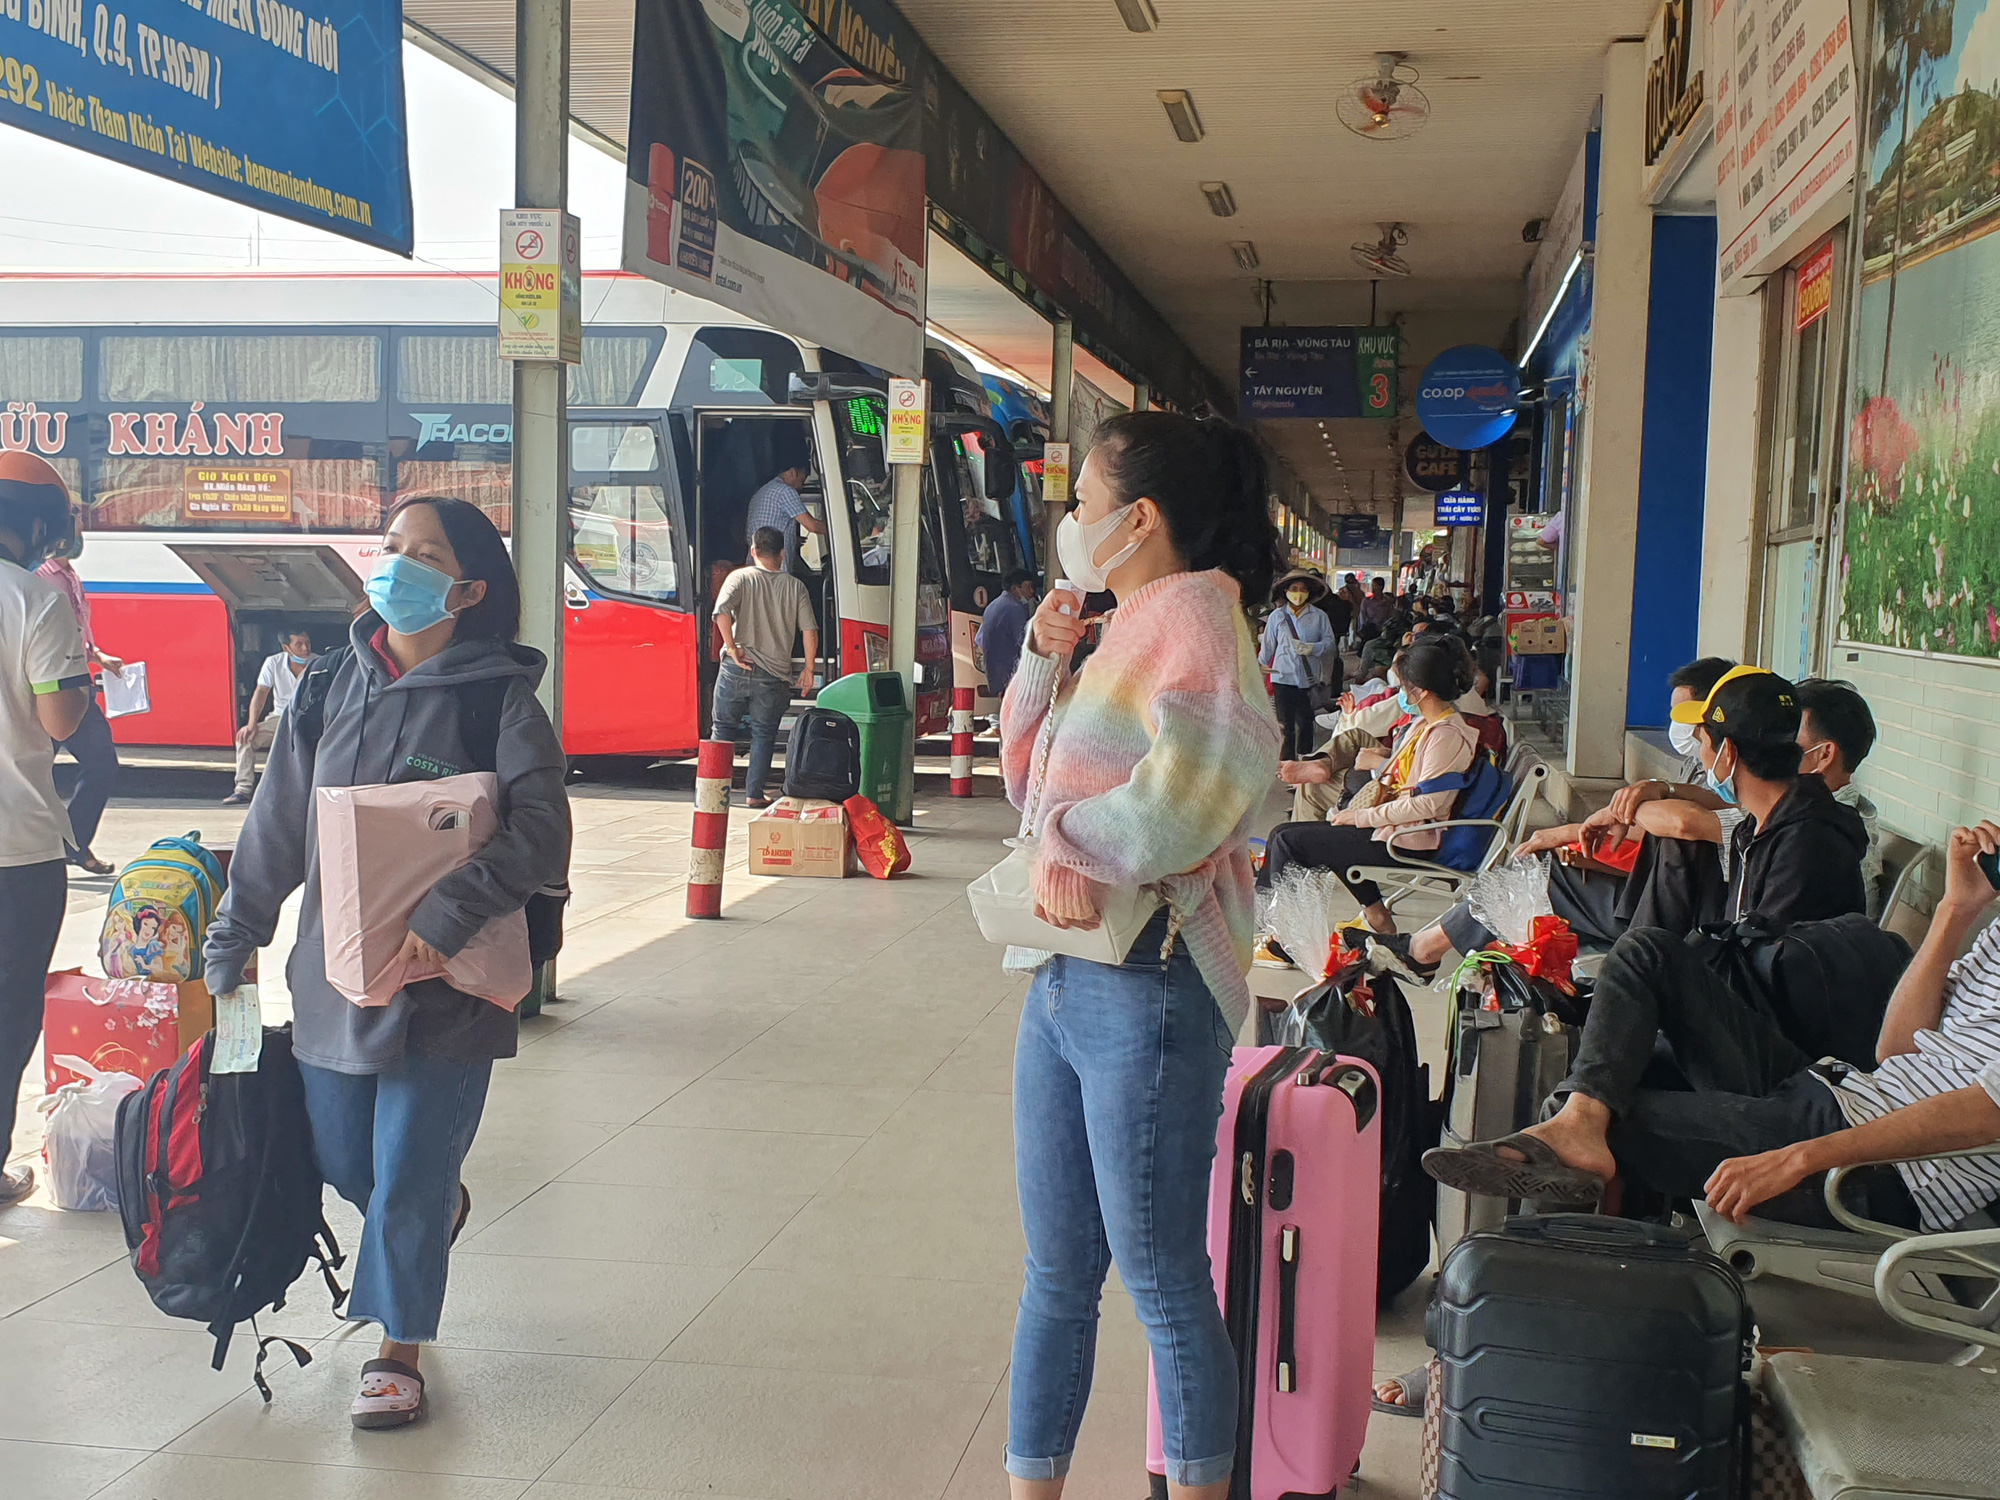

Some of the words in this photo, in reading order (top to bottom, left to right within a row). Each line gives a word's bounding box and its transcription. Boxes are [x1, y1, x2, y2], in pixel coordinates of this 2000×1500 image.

[93, 3, 134, 77] Q.9,
[137, 22, 210, 101] TP.HCM
[307, 17, 338, 75] MỚI
[45, 79, 86, 131] Hoặc
[88, 95, 128, 143] Tham
[128, 111, 165, 156] Khảo
[165, 125, 188, 169] Tại
[188, 133, 243, 183] Website:
[244, 154, 373, 227] benxemiendong.com.vn
[504, 265, 555, 292] KHÔNG
[1254, 336, 1267, 348] BÀ
[1297, 337, 1328, 348] VŨNG
[1330, 337, 1351, 348] TÀU
[1358, 336, 1376, 354] KHU
[1253, 385, 1272, 396] TÂY
[1275, 385, 1323, 396] NGUYÊN
[1369, 373, 1389, 408] 3
[1422, 387, 1465, 400] co.op
[108, 401, 284, 455] KHÁNH
[408, 413, 513, 453] TRACO
[1416, 460, 1457, 476] CAFE
[1453, 505, 1466, 513] CÂY
[406, 756, 439, 774] COSTA
